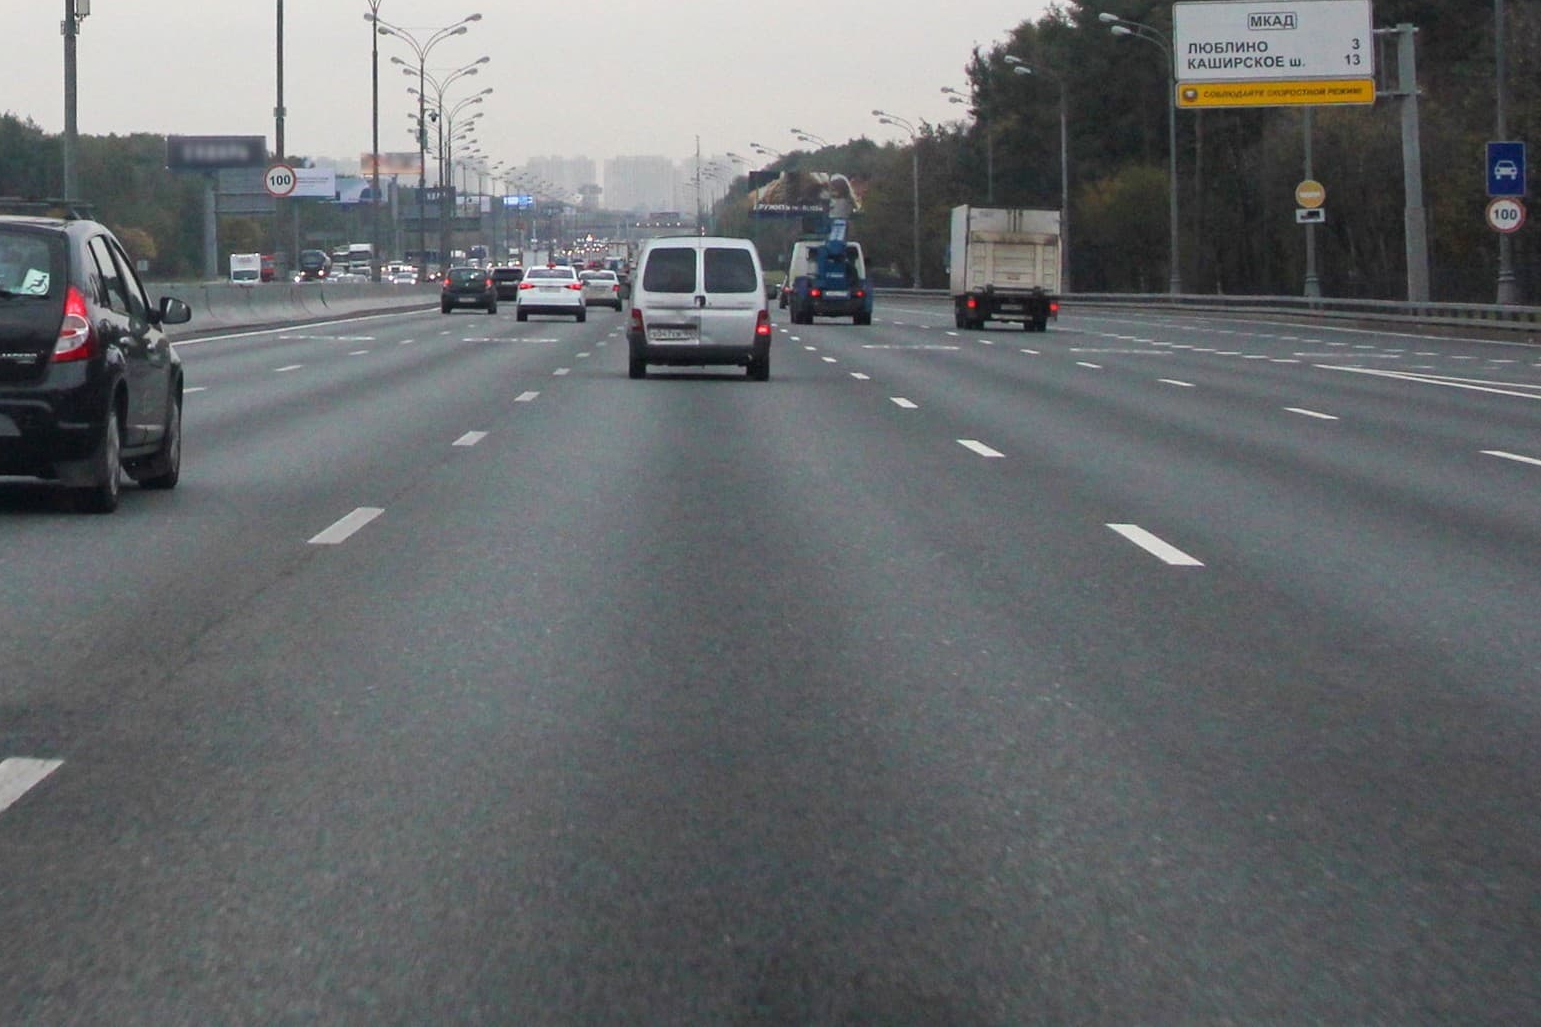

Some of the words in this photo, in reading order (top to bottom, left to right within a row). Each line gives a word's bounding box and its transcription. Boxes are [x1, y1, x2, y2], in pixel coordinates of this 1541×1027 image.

[1250, 14, 1295, 28] МКАД
[1187, 41, 1269, 54] ЛЮБЛИНО
[1351, 38, 1361, 50] 3
[1187, 55, 1285, 70] КАШИРСКОЕ
[1289, 57, 1307, 68] ш.
[1344, 54, 1361, 66] 13
[269, 175, 291, 186] 100
[1494, 208, 1518, 221] 100
